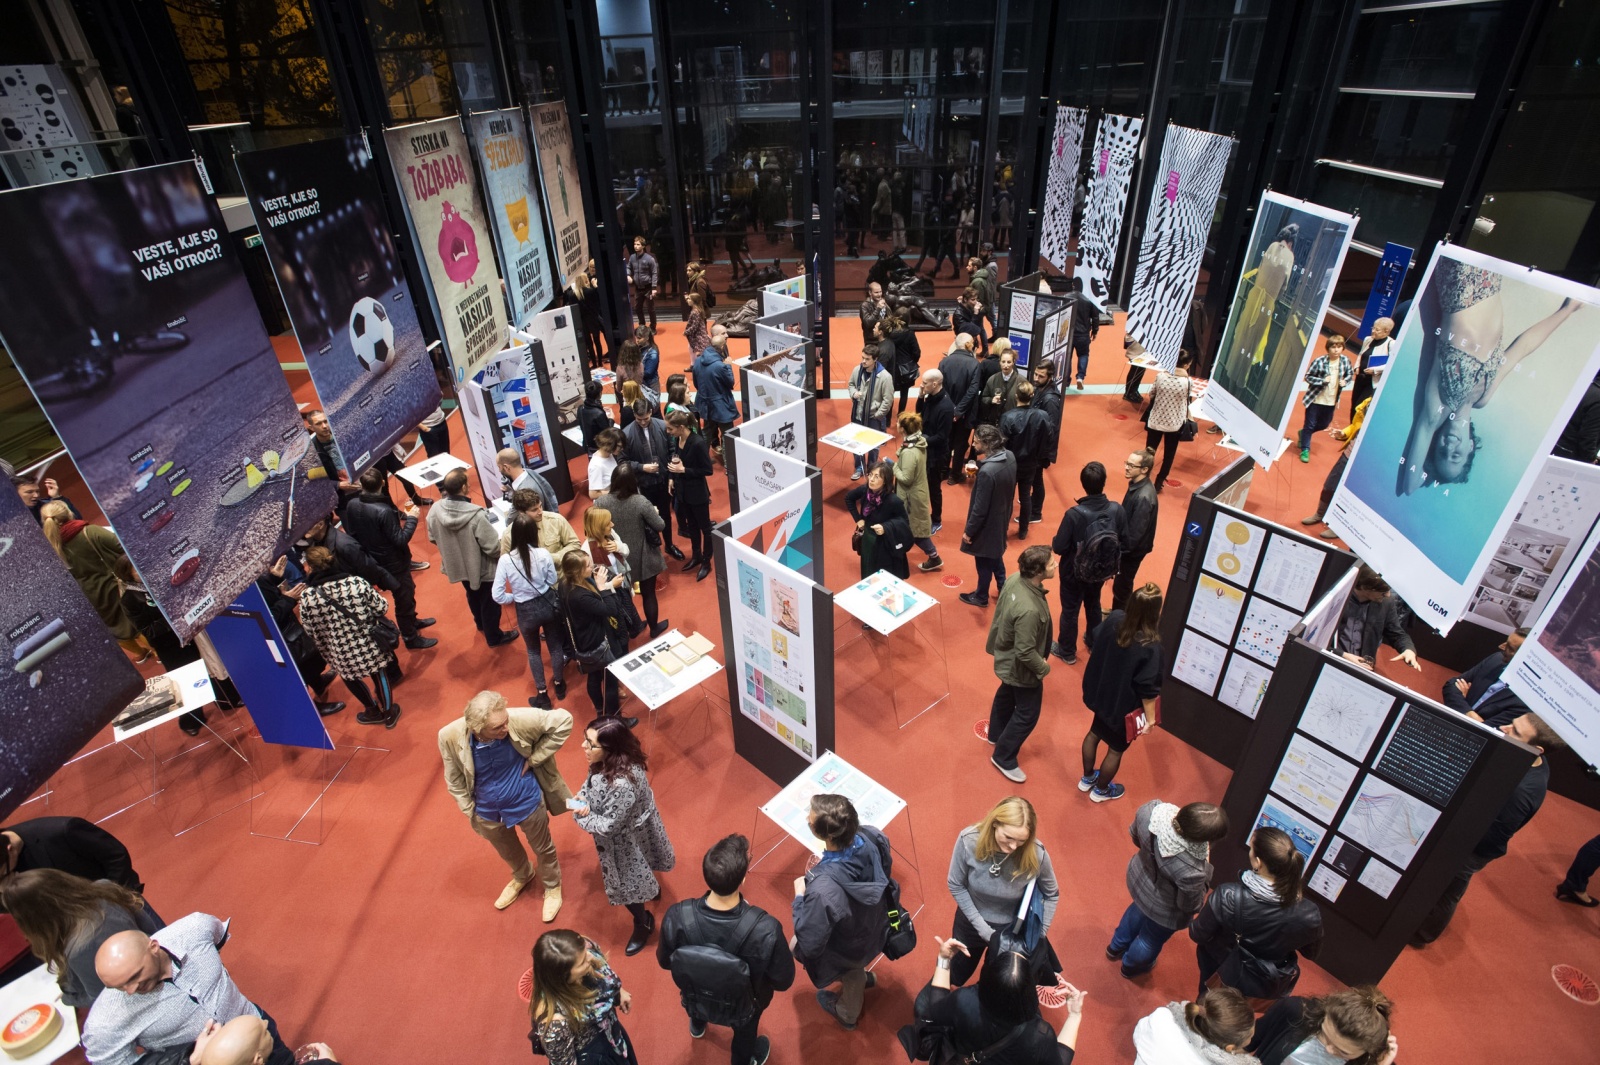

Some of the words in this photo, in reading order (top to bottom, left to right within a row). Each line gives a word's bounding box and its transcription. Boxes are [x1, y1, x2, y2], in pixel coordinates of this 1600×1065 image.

[410, 132, 441, 155] STISKA
[440, 130, 450, 148] NI
[407, 154, 468, 202] TOŽIBABA
[260, 196, 292, 212] VESTE,
[290, 191, 307, 204] KJE
[306, 188, 318, 200] SO
[266, 210, 288, 228] VAŠI
[288, 201, 321, 222] OTROCI?
[132, 240, 179, 263] VESTE,
[178, 232, 202, 250] KJE
[201, 228, 218, 243] SO
[141, 258, 174, 282] VAŠI
[174, 243, 223, 271] OTROCI?
[518, 257, 541, 289] NASILJU
[459, 295, 493, 339] NASILJU
[1261, 307, 1279, 319] KOT
[466, 317, 497, 354] SPREGOVORI
[468, 356, 474, 368] NA
[1435, 327, 1536, 379] SVETLOBA
[1437, 405, 1468, 427] KOT
[1399, 457, 1450, 497] BARVA
[1427, 599, 1448, 618] UGM
[10, 616, 40, 639] rokpolanc
